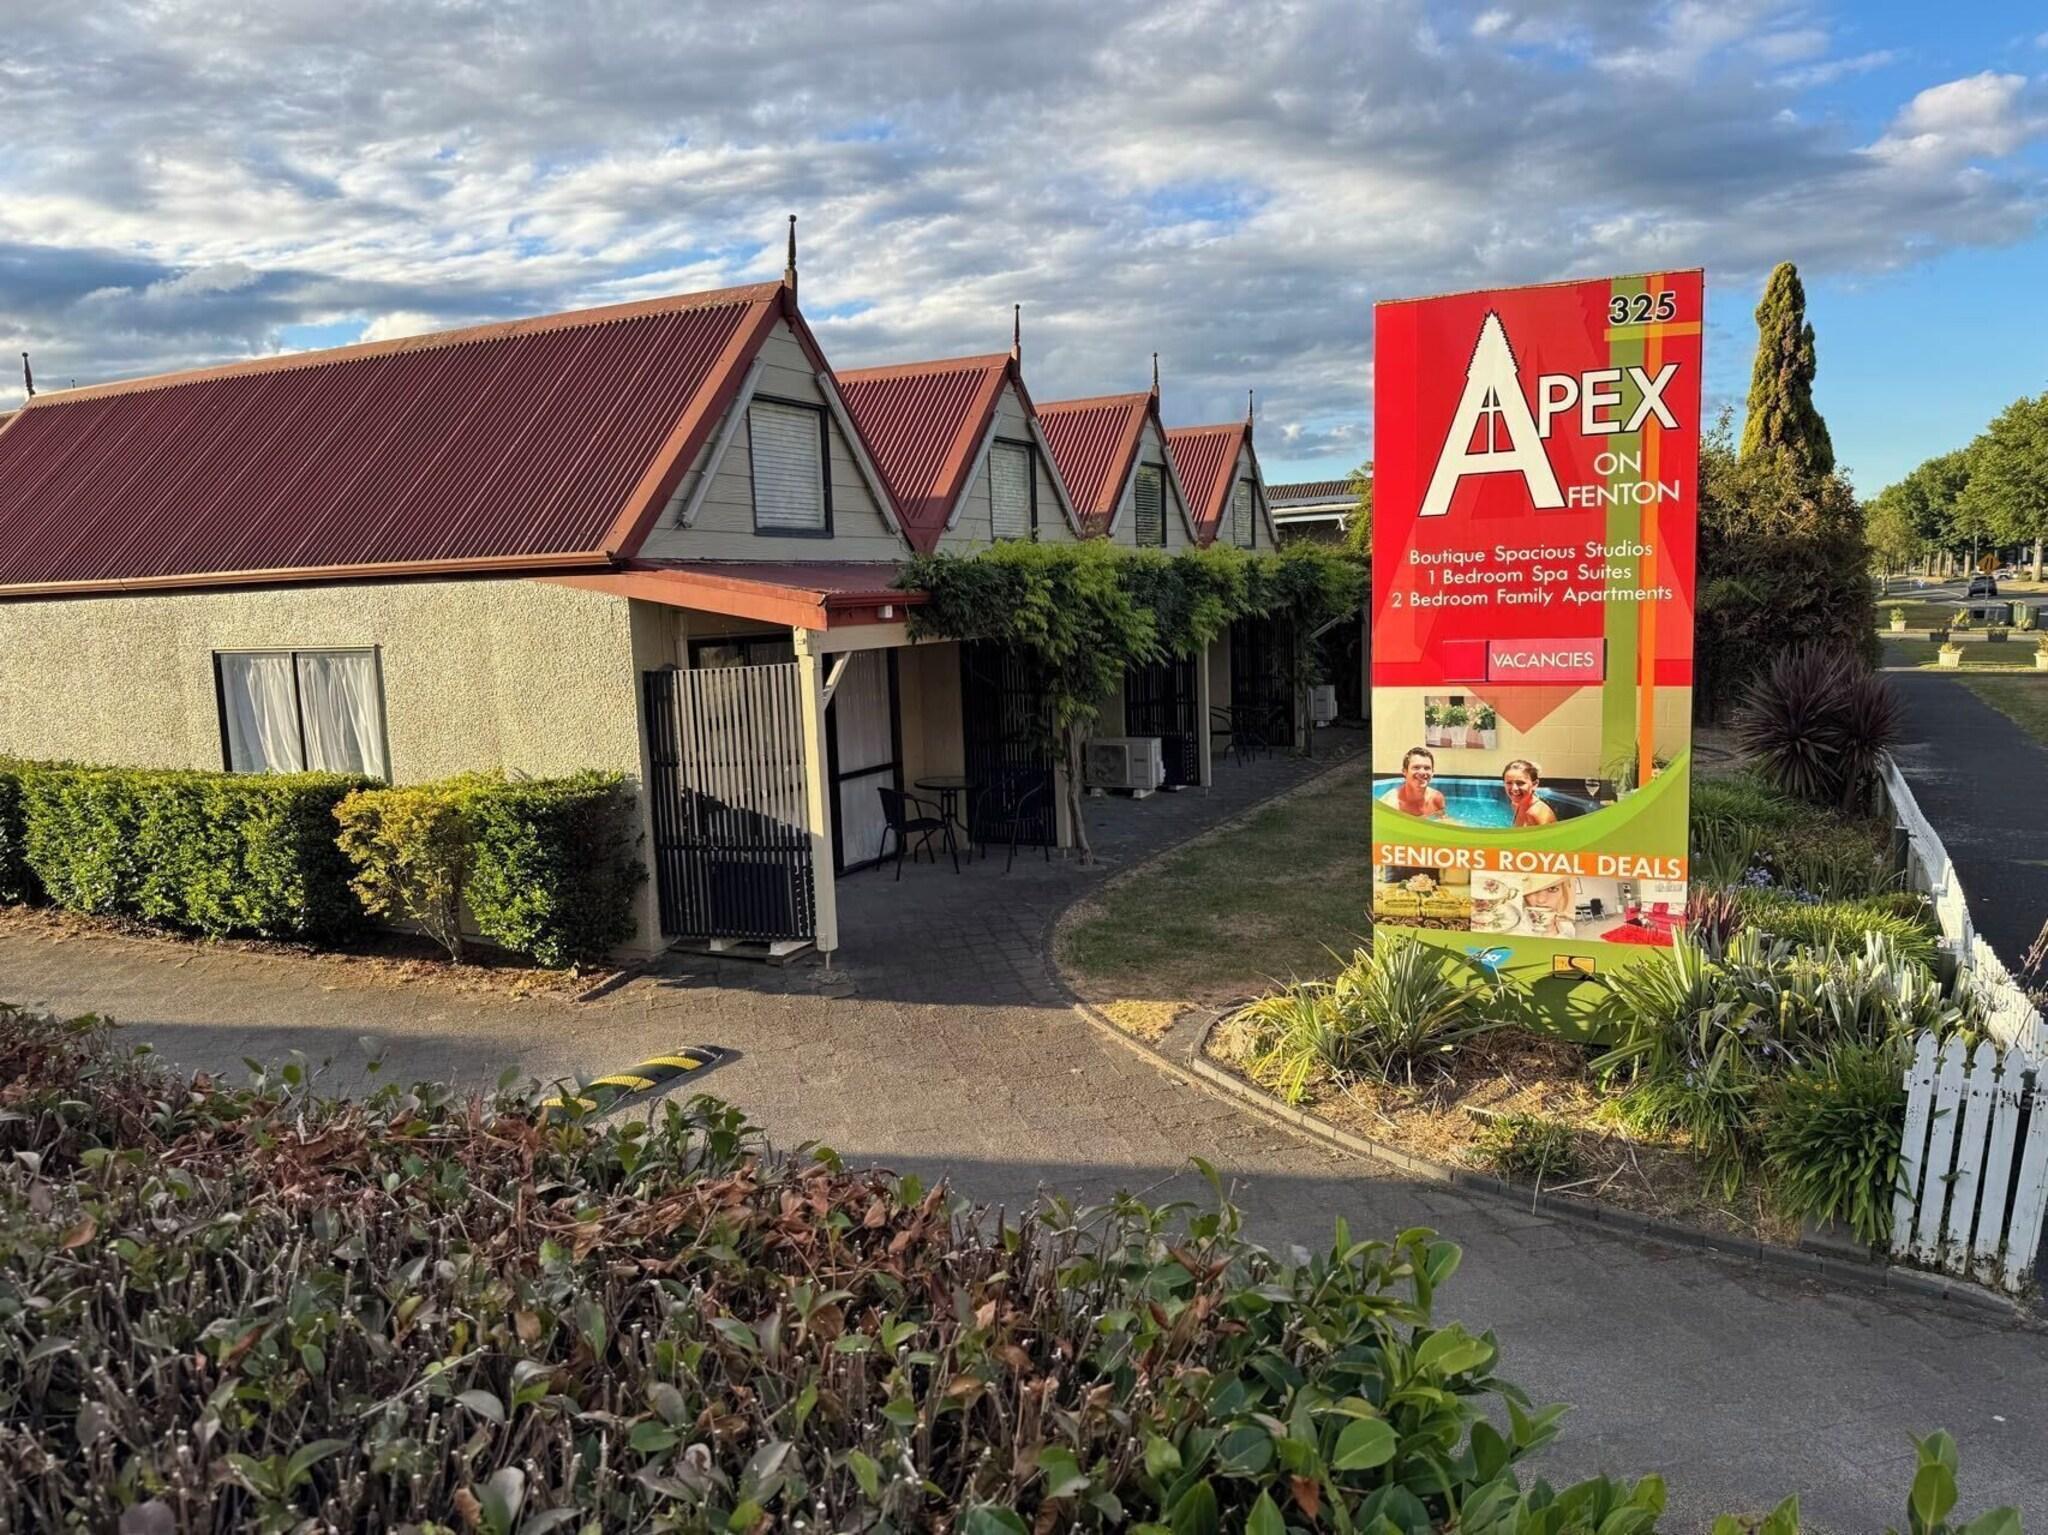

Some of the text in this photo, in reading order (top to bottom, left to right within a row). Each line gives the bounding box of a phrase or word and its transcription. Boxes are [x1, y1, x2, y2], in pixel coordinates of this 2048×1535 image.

[1609, 291, 1676, 324] 325
[1418, 310, 1681, 518] APEX
[1594, 451, 1641, 475] ON
[1568, 480, 1680, 508] FENTON
[1409, 540, 1653, 567] Boutique Spacious Studios
[1428, 564, 1632, 585] 1 Bedroom Spa Suites
[1392, 587, 1673, 608] 2 Bedroom Family Apartments
[1492, 652, 1594, 668] VACANCIES
[1381, 844, 1681, 878] SENIORS ROYAL DEALS
